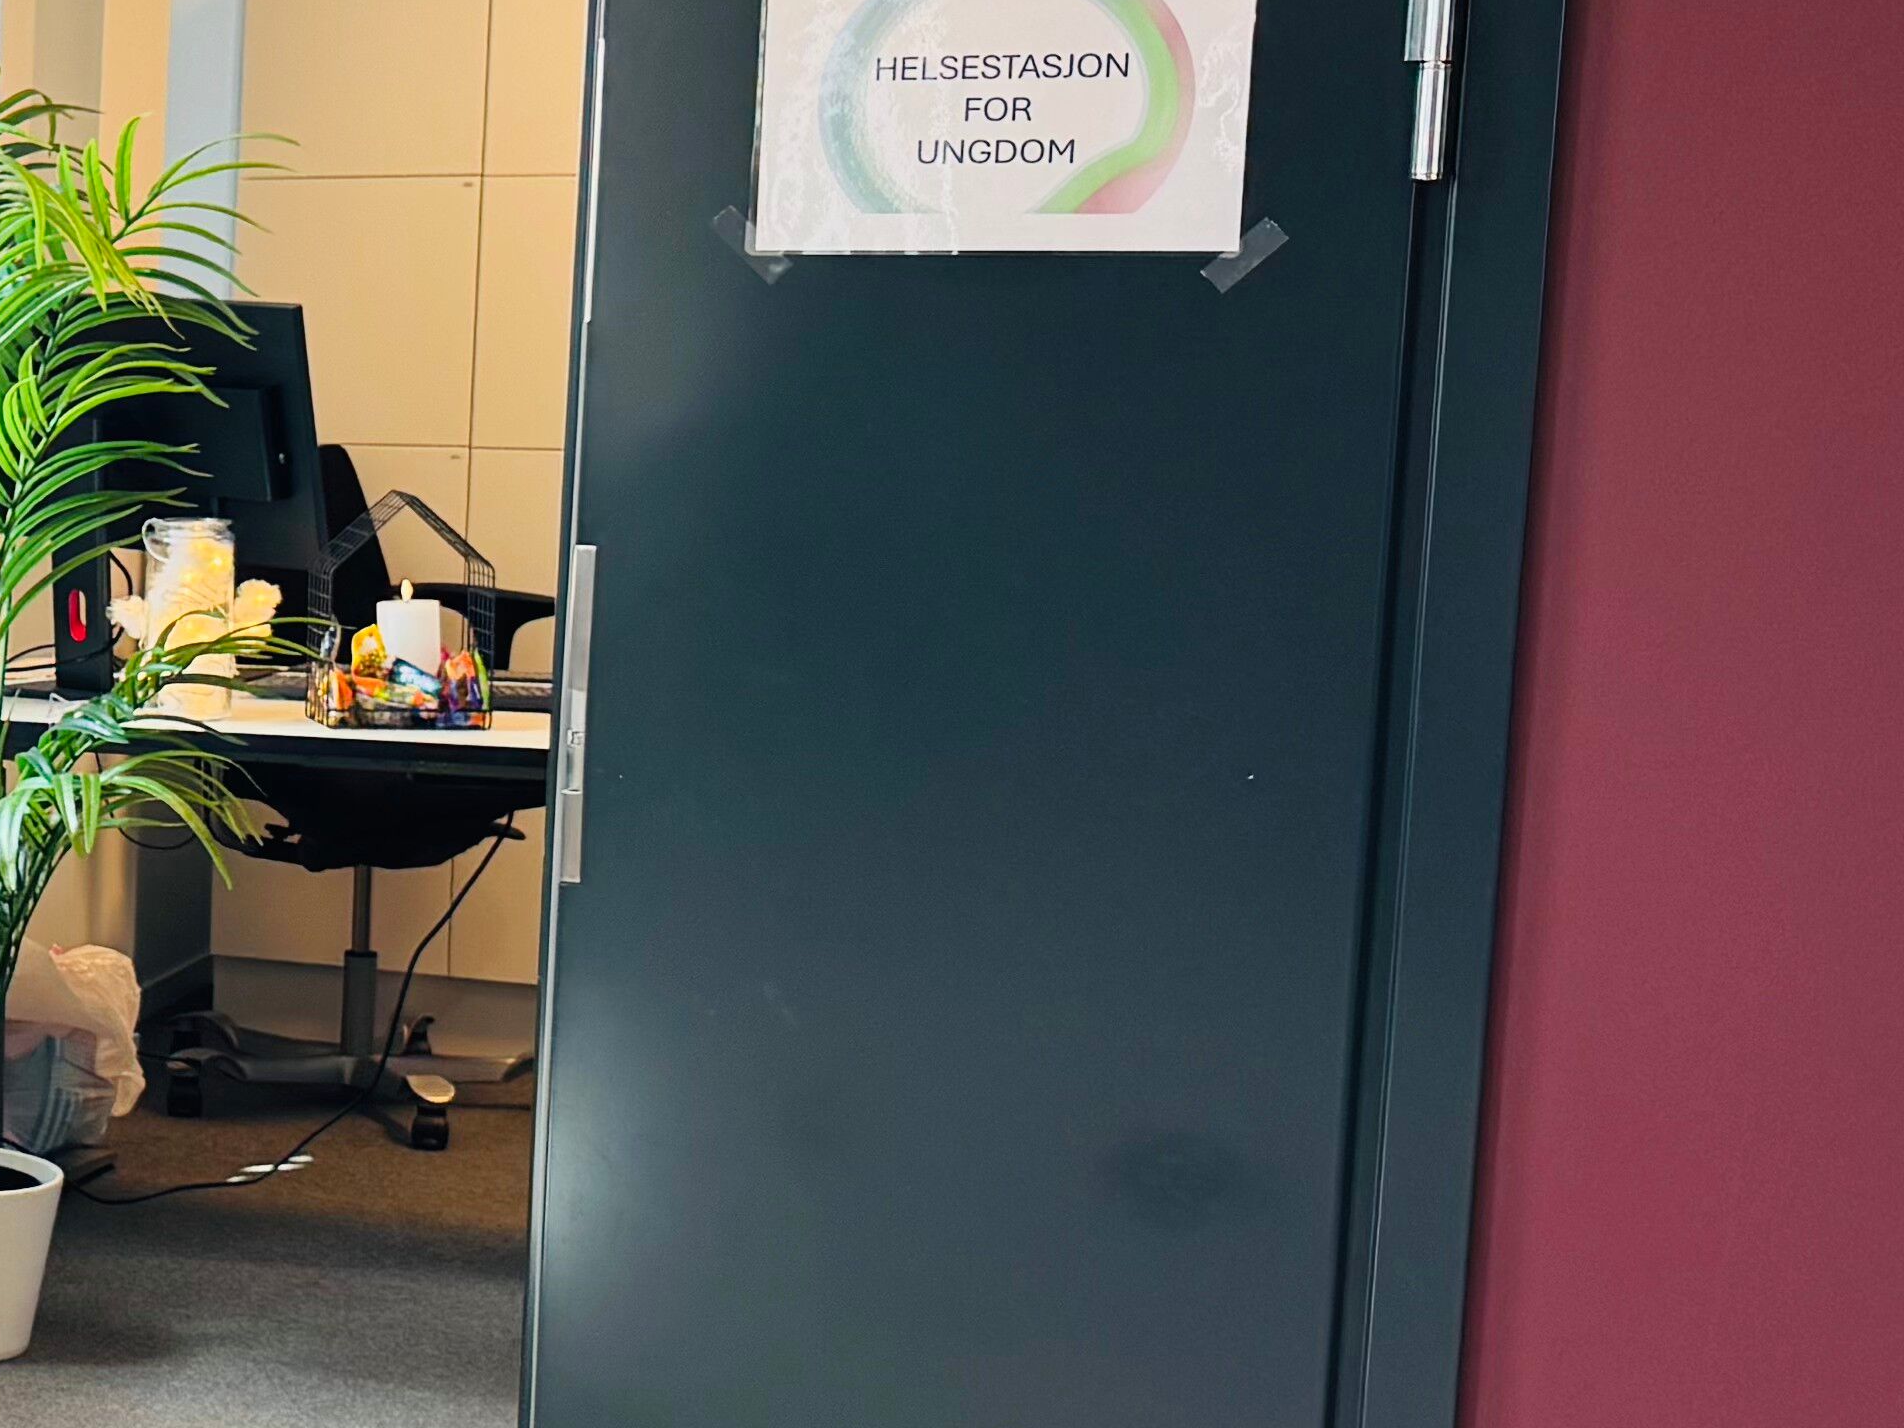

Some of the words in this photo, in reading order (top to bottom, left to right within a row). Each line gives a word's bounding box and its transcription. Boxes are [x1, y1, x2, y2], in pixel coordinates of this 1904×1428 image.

[876, 52, 1130, 81] HELSESTASJON
[964, 96, 1032, 122] FOR
[917, 138, 1075, 165] UNGDOM
